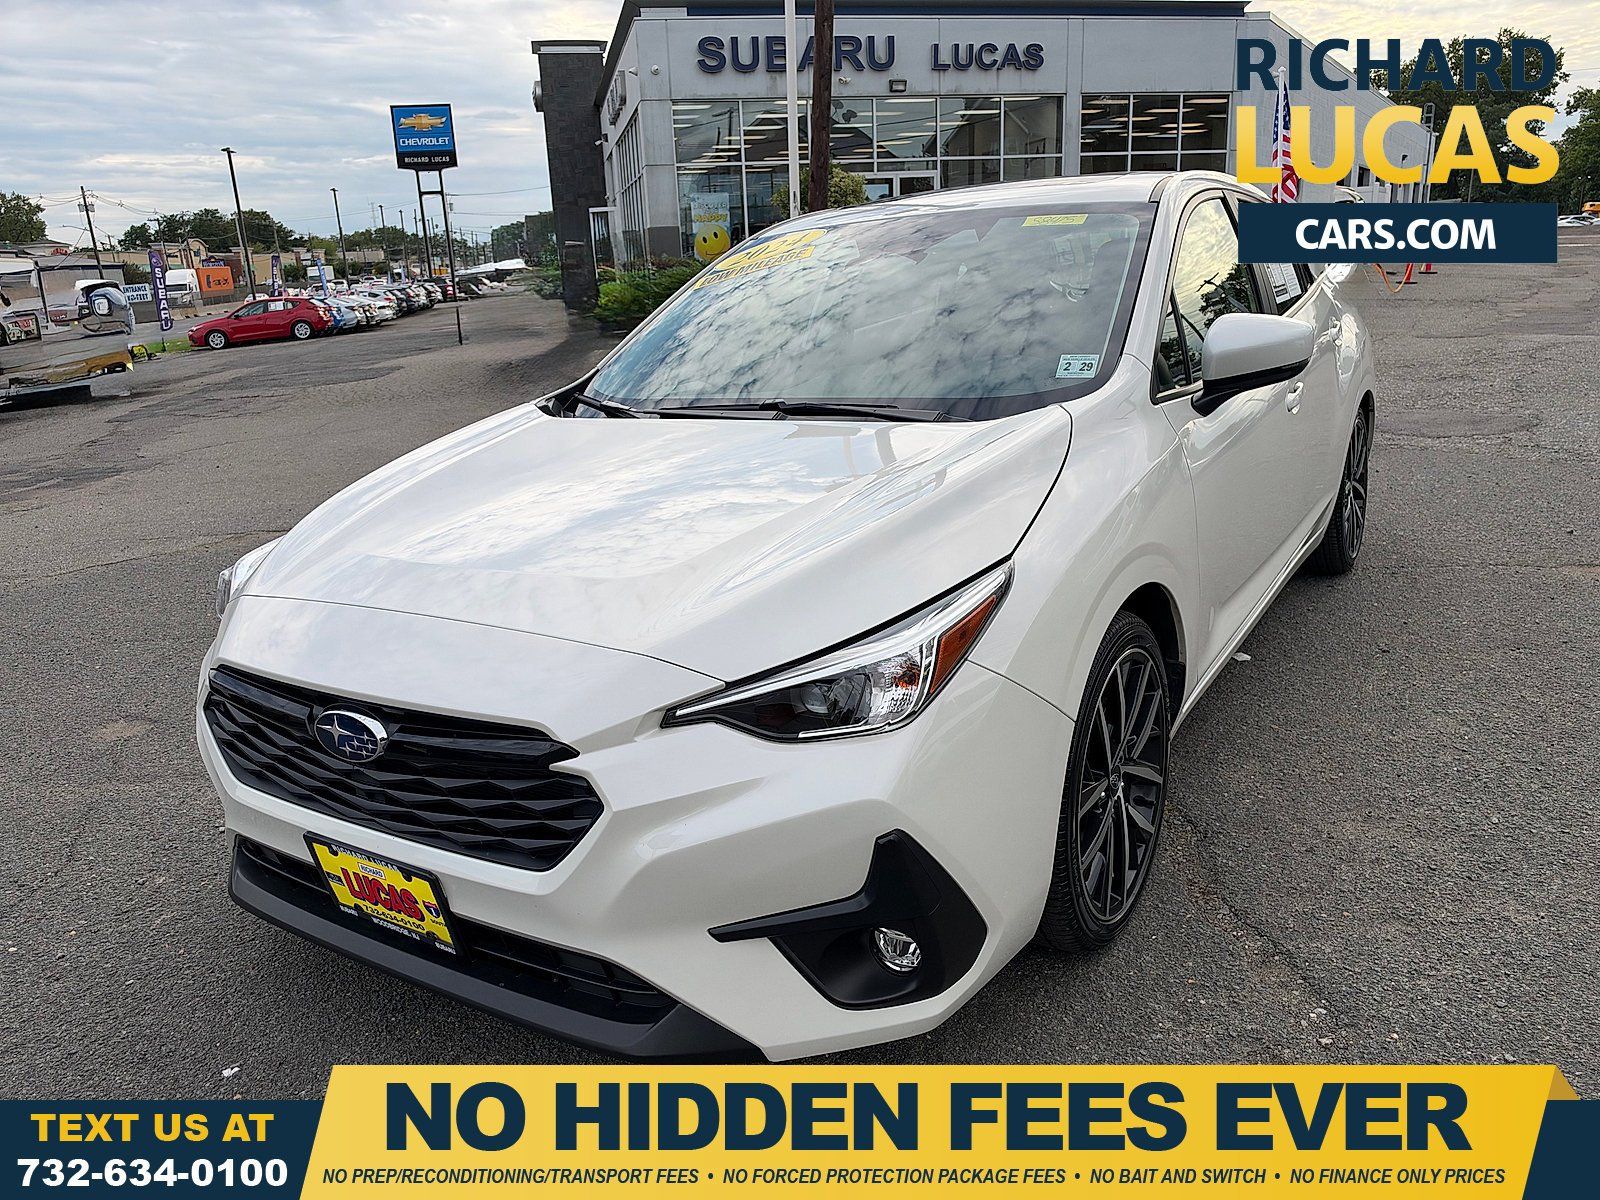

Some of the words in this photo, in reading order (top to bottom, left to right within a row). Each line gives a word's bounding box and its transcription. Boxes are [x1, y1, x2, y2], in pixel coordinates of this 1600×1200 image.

[697, 36, 896, 73] SUBARU
[931, 43, 1045, 71] LUCAS
[400, 137, 449, 146] CHEVROLET
[693, 213, 728, 223] HAPPY
[734, 248, 809, 276] MILEAGE
[154, 267, 172, 331] SUBARU
[1063, 361, 1072, 371] 2
[1079, 361, 1094, 372] 29
[331, 844, 369, 862] RICHARD
[360, 864, 384, 878] RICHARD
[340, 866, 425, 923] LUCAS
[363, 903, 426, 931] 732-634-0100
